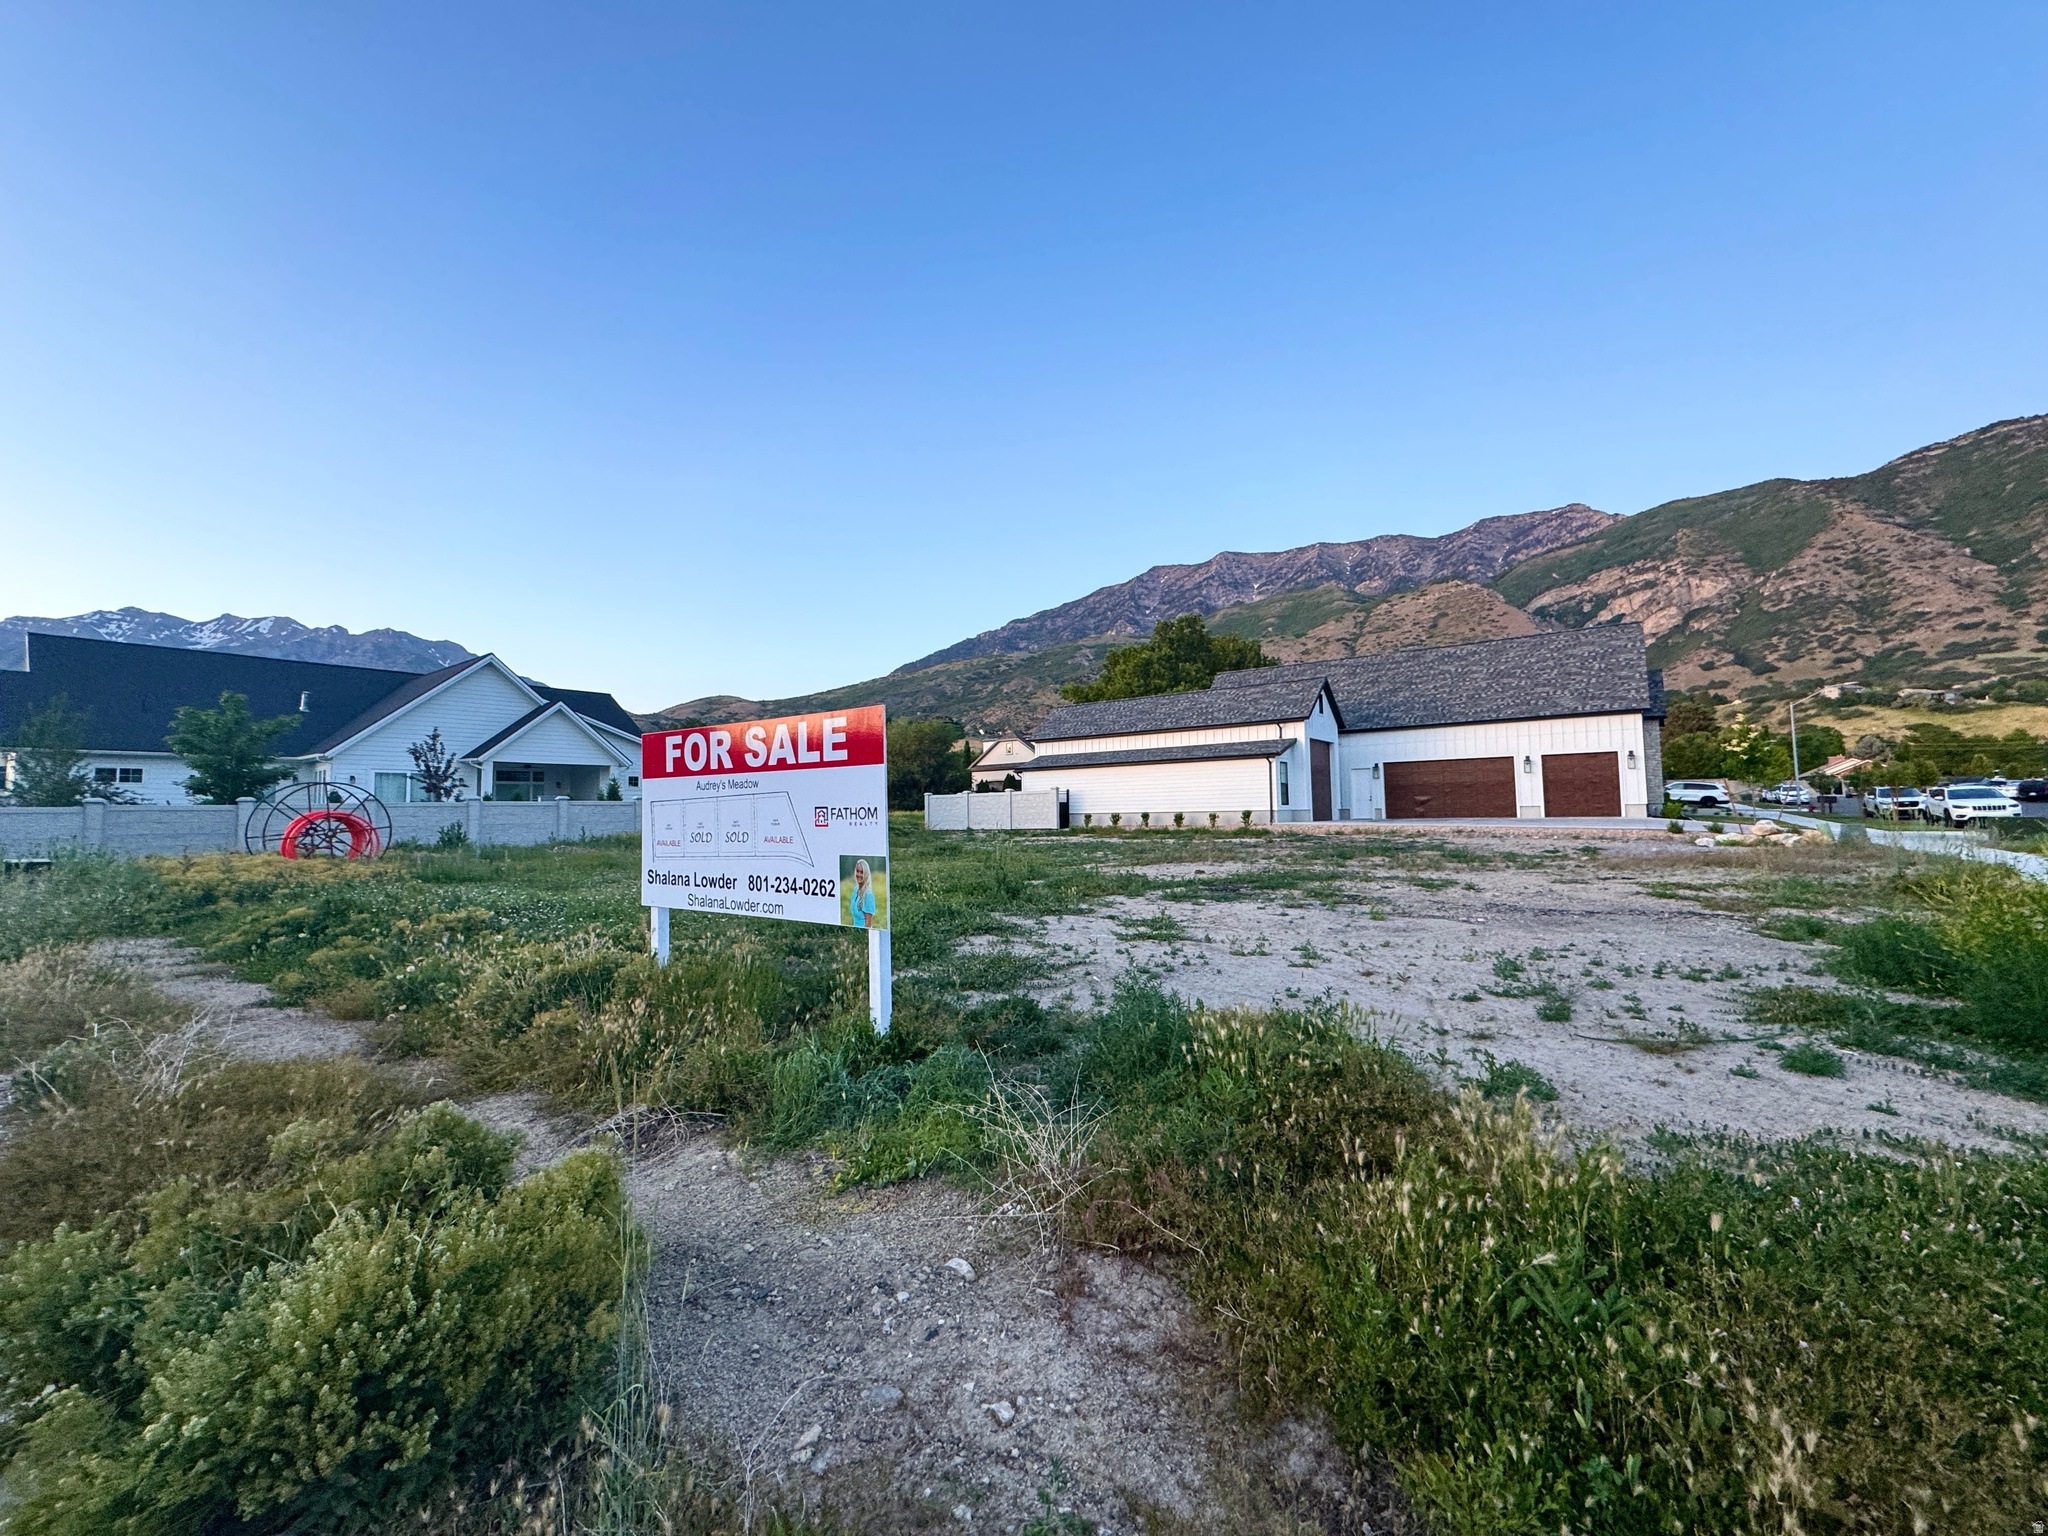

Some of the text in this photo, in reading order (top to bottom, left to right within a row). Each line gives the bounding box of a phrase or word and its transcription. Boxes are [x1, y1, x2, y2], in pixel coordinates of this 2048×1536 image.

[665, 716, 848, 773] FOR SALE
[696, 779, 759, 792] Audrey's Meadow
[830, 807, 878, 820] FATHOM
[656, 839, 681, 847] AVAILABLE
[690, 832, 713, 844] SOLD
[725, 831, 749, 844] SOLD
[764, 836, 794, 844] AVAILABLE
[647, 870, 836, 898] Shalana Lowder 801-234-0262
[687, 894, 784, 915] ShalanaLowder.com
